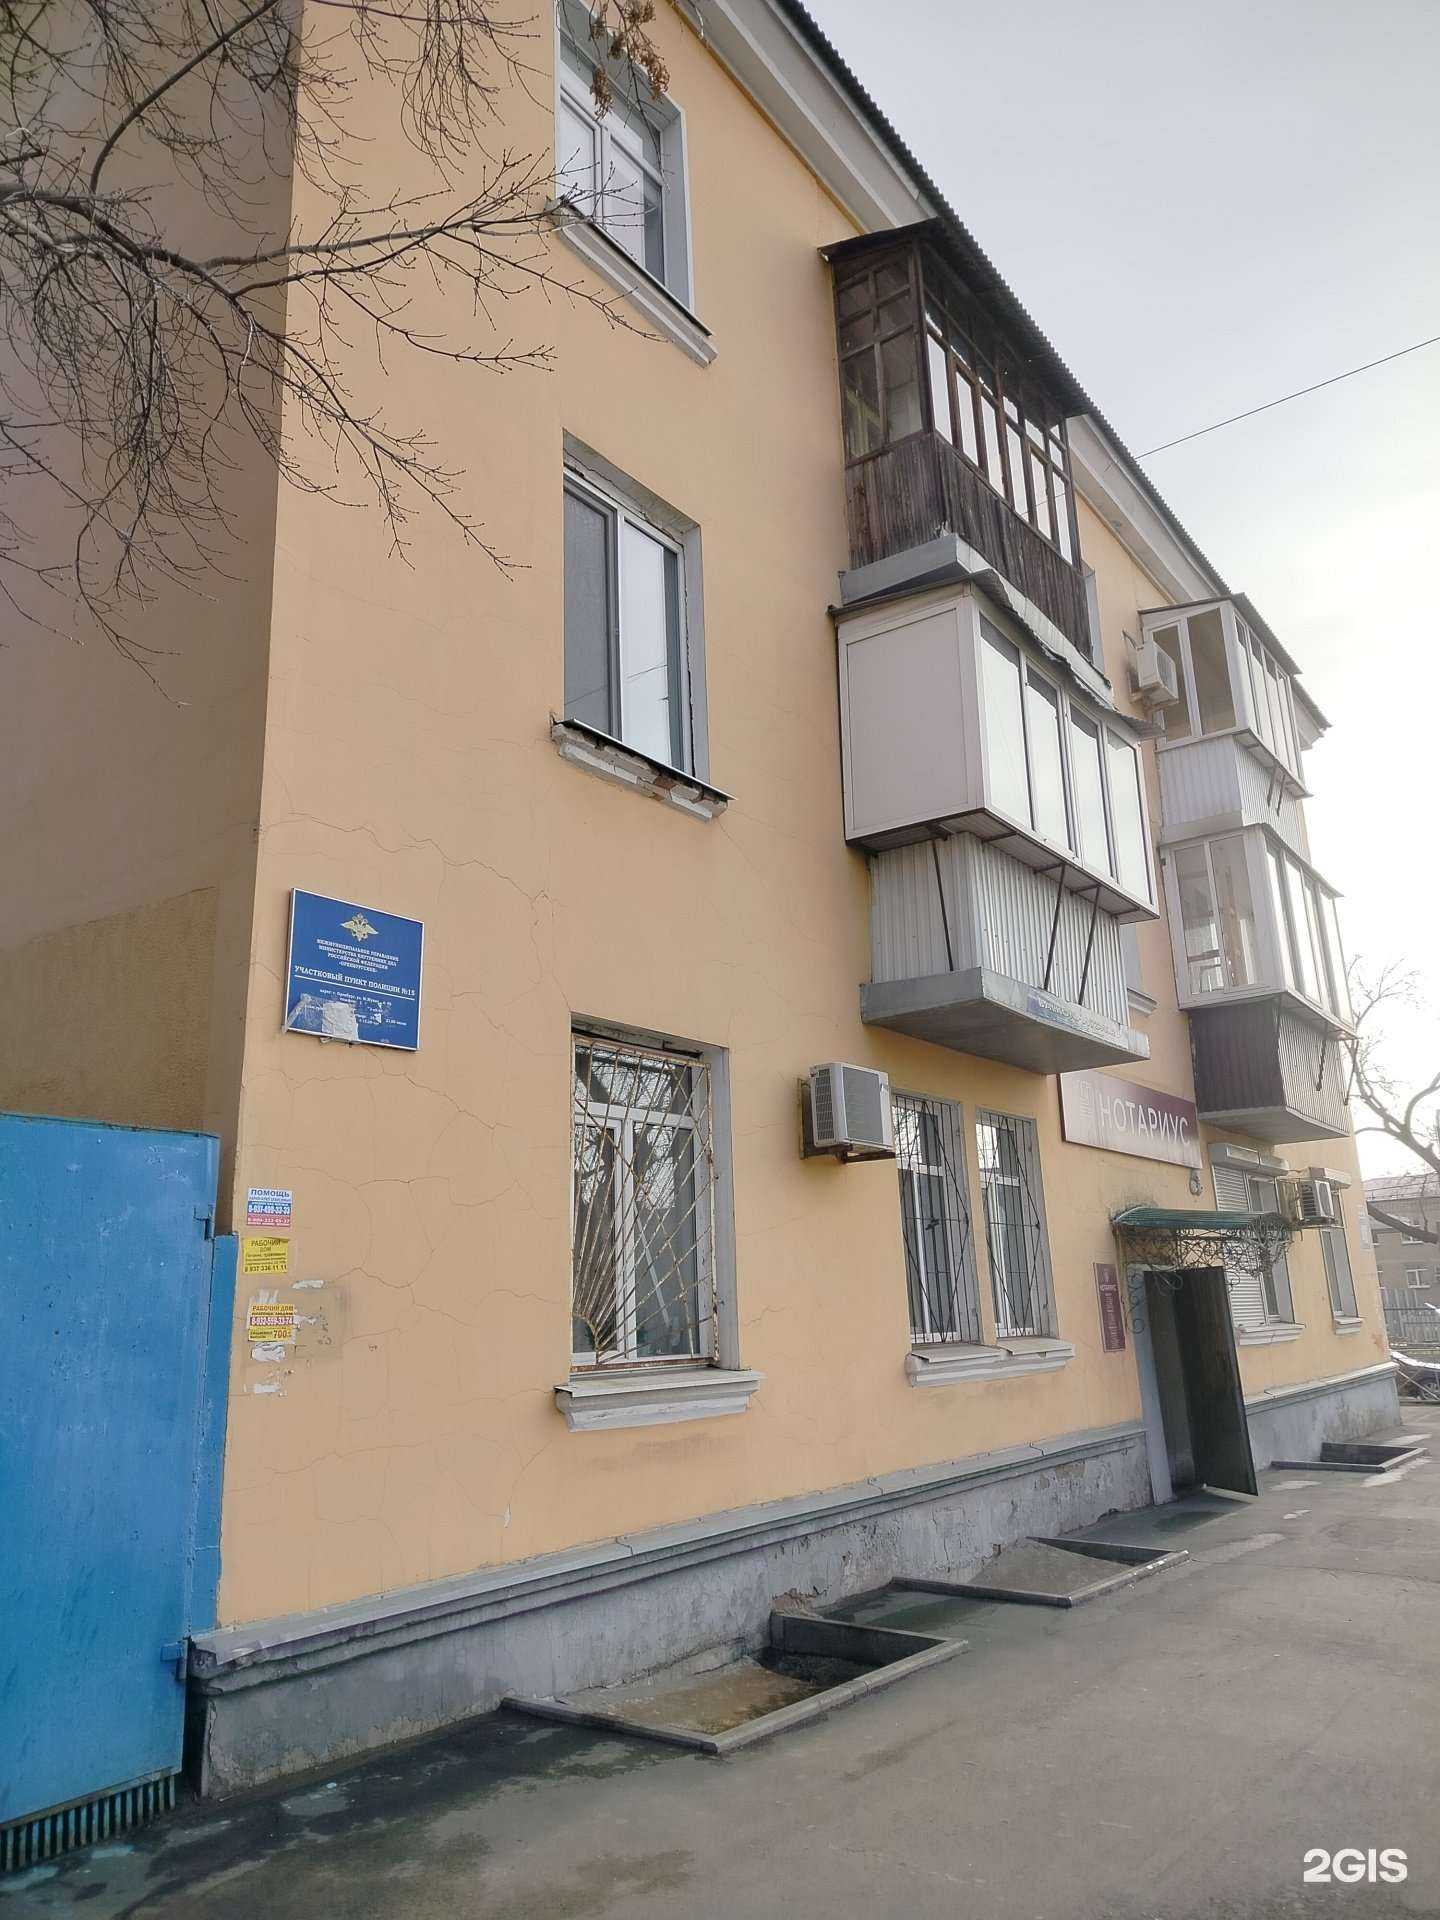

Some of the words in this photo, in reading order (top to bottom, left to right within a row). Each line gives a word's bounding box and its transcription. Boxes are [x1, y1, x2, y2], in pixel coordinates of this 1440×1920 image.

[294, 965, 343, 981] УЧАСТКОВЫЙ
[344, 977, 368, 987] ПУНКТ
[368, 981, 401, 993] ПОЛИЦИИ
[1098, 1092, 1190, 1146] НОТАРИУС
[250, 1189, 290, 1198] ПОМОЩЬ
